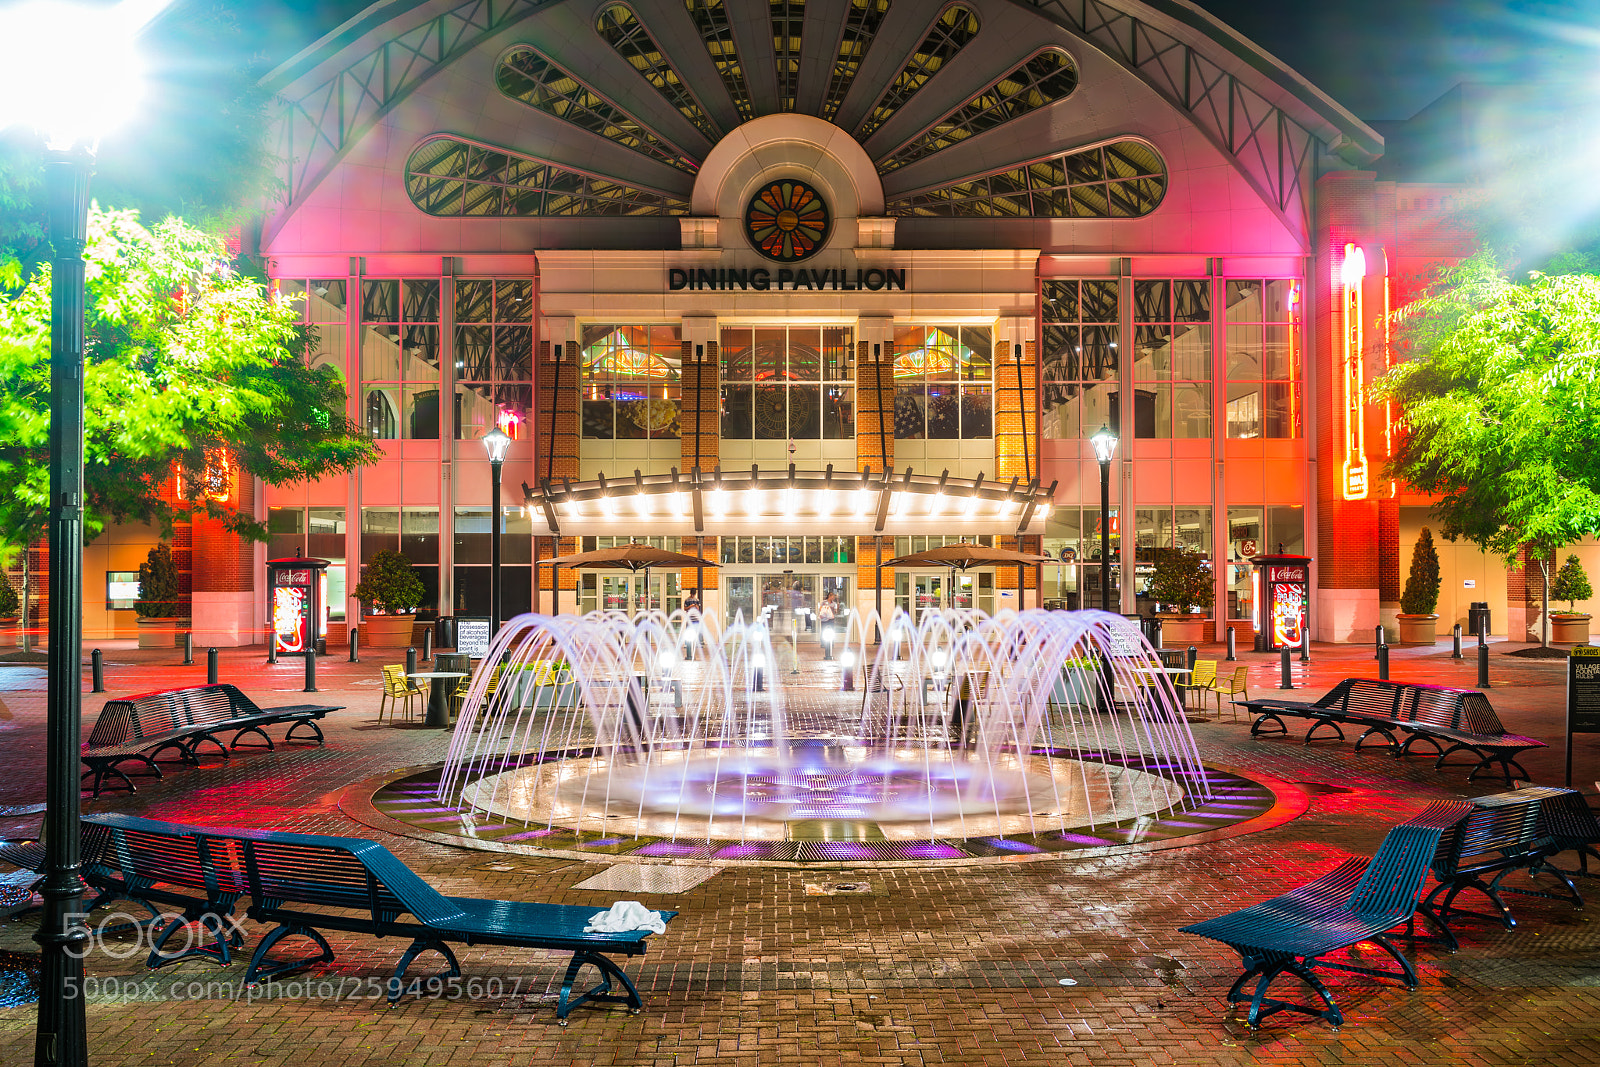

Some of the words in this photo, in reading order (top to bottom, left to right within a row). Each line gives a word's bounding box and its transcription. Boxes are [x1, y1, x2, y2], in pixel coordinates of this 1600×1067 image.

[669, 268, 770, 291] DINING
[778, 268, 906, 291] PAVILION
[1583, 648, 1598, 656] SHOES
